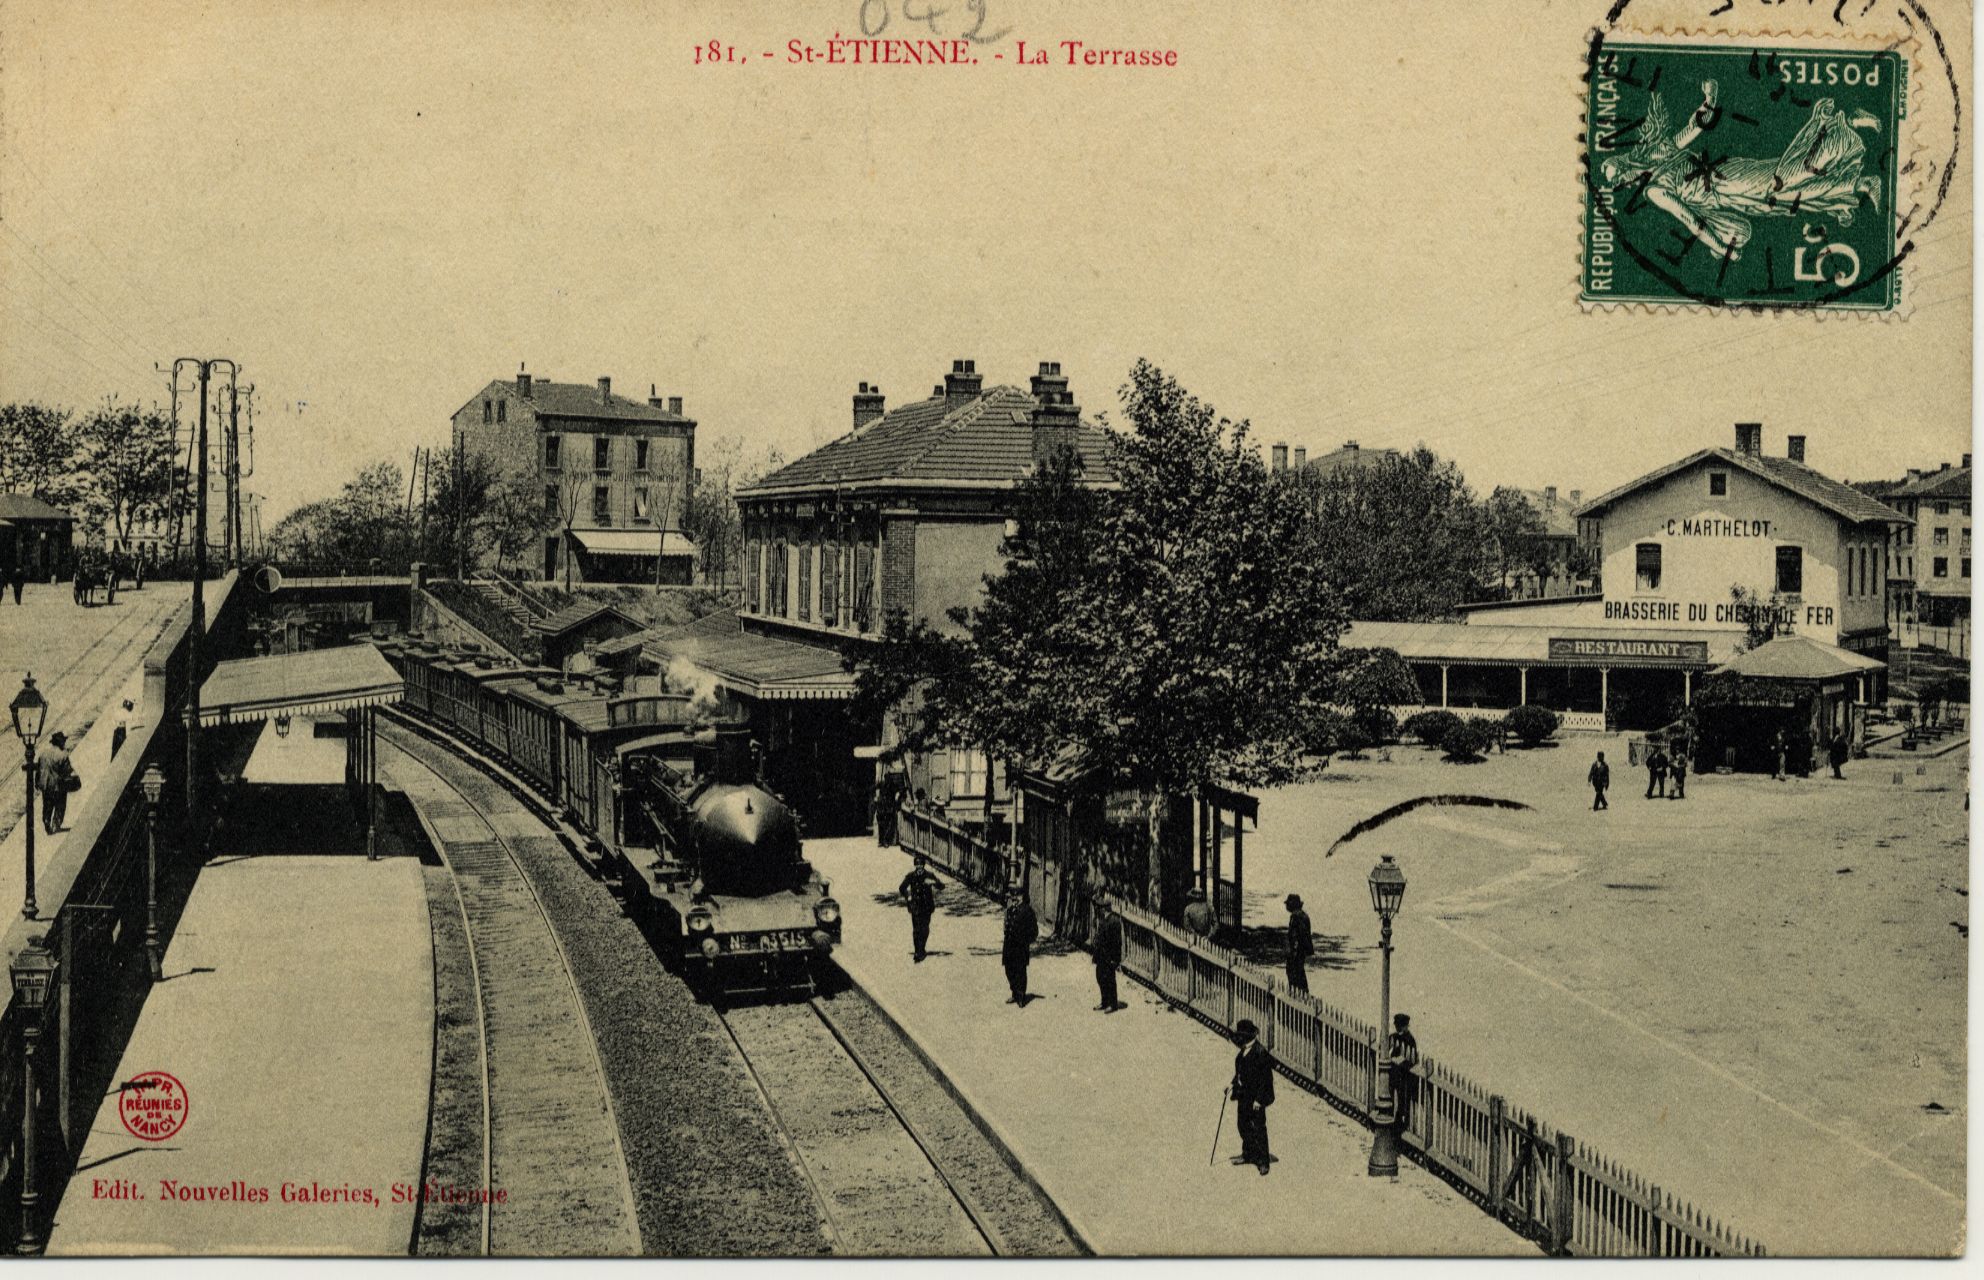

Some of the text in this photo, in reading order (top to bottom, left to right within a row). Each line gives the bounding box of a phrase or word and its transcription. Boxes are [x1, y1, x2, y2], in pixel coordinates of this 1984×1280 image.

[1779, 60, 1880, 86] POSTES
[1604, 601, 1680, 622] BRASSERIE
[1688, 603, 1707, 622] DU
[1779, 606, 1797, 624] DE
[1806, 606, 1834, 625] FER
[1574, 640, 1680, 657] RESTAURANT
